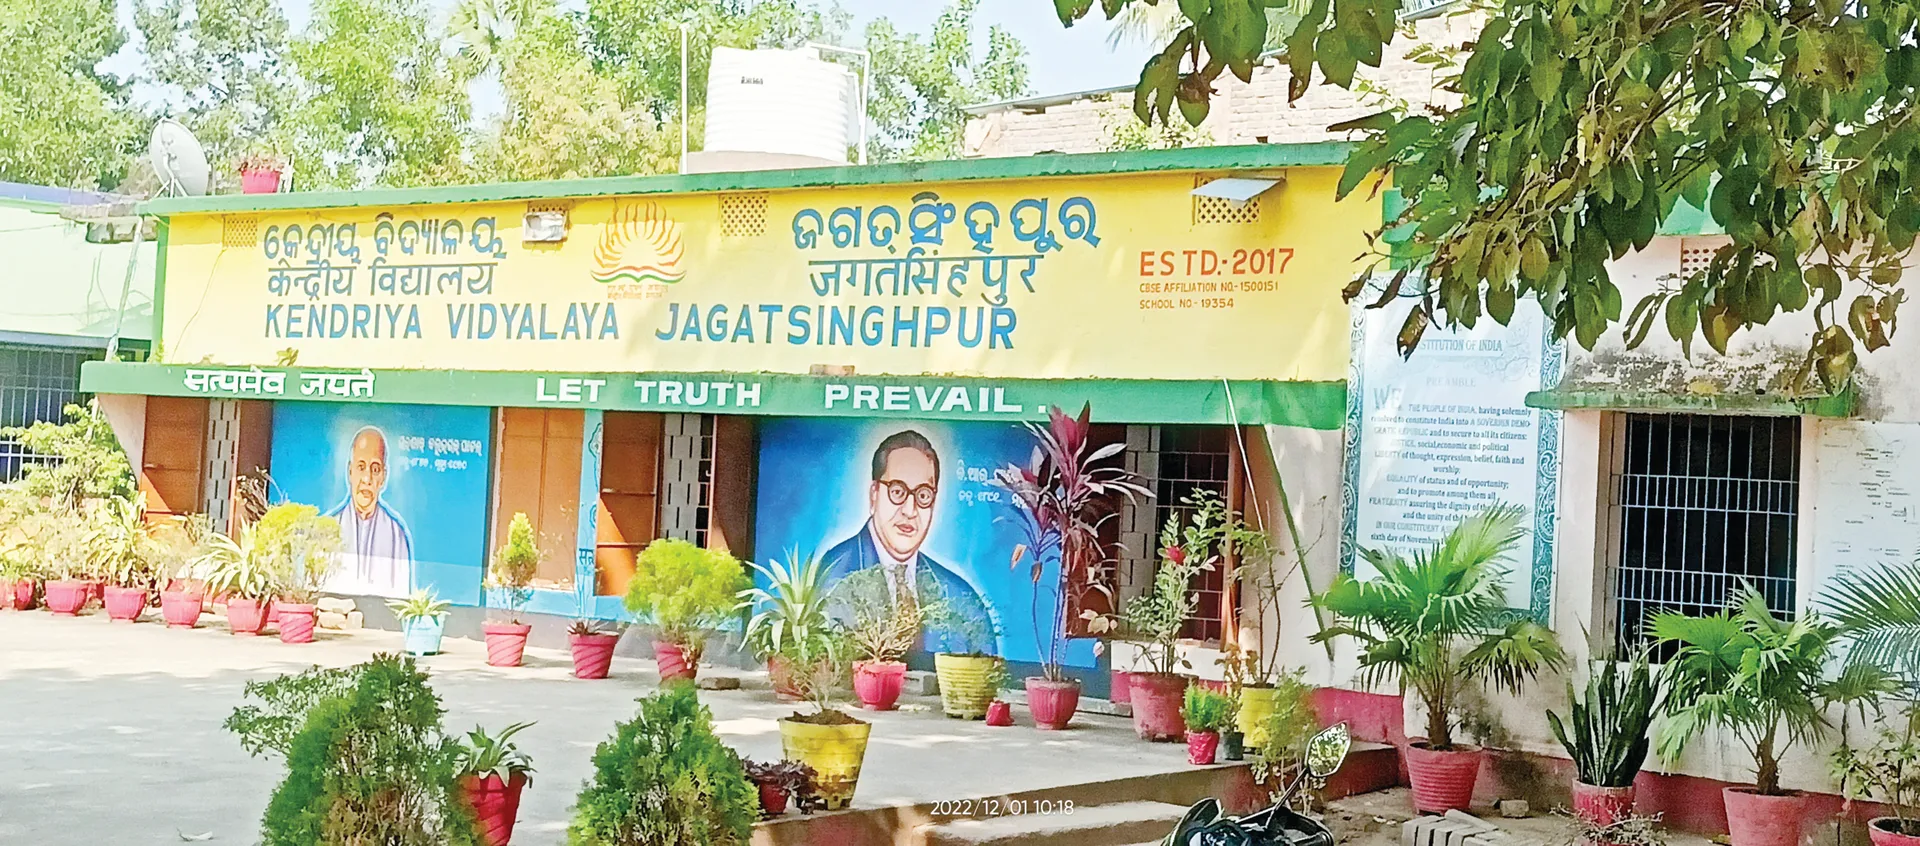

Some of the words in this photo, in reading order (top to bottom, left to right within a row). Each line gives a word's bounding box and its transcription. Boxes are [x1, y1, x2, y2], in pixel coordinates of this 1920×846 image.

[267, 257, 357, 301] केन्द्रीय
[367, 256, 499, 296] विद्यालय
[1139, 282, 1161, 293] CBSE
[1163, 281, 1217, 293] AFFILIATION
[1139, 299, 1175, 309] SCHOOL
[265, 303, 422, 339] KENDRIYA
[446, 302, 620, 341] VIDYALAYA
[655, 302, 1018, 350] JAGATSINGHPUR
[1465, 340, 1477, 351] OF
[1479, 340, 1502, 351] INDIA
[183, 366, 287, 395] सत्यमेव
[300, 367, 376, 398] जयते
[535, 377, 606, 403] LET
[634, 380, 762, 407] TRUTH
[1409, 404, 1420, 412] THE
[1422, 404, 1447, 413] PEOPLE
[1448, 405, 1456, 413] OF
[1479, 406, 1500, 416] having
[1501, 407, 1532, 417] solemnly
[1406, 416, 1437, 424] constitute
[1430, 429, 1442, 437] and
[1451, 430, 1472, 438] secure
[1491, 431, 1499, 439] its
[1482, 443, 1509, 451] political
[1402, 451, 1408, 459] of
[1495, 455, 1510, 464] faith
[1419, 476, 1426, 484] of
[1427, 477, 1446, 485] status
[1460, 478, 1467, 486] of
[1397, 487, 1410, 495] and
[1410, 487, 1417, 495] to
[1418, 489, 1445, 497] promote
[1446, 491, 1468, 500] among
[1469, 491, 1486, 499] them
[1487, 492, 1496, 500] all
[1409, 500, 1436, 510] assuring
[1437, 501, 1447, 509] the
[1448, 502, 1471, 511] dignity
[1402, 511, 1415, 519] and
[1427, 513, 1444, 522] unity
[1397, 522, 1440, 532] CONSTITUENT
[1387, 534, 1398, 543] day
[1399, 534, 1406, 542] of
